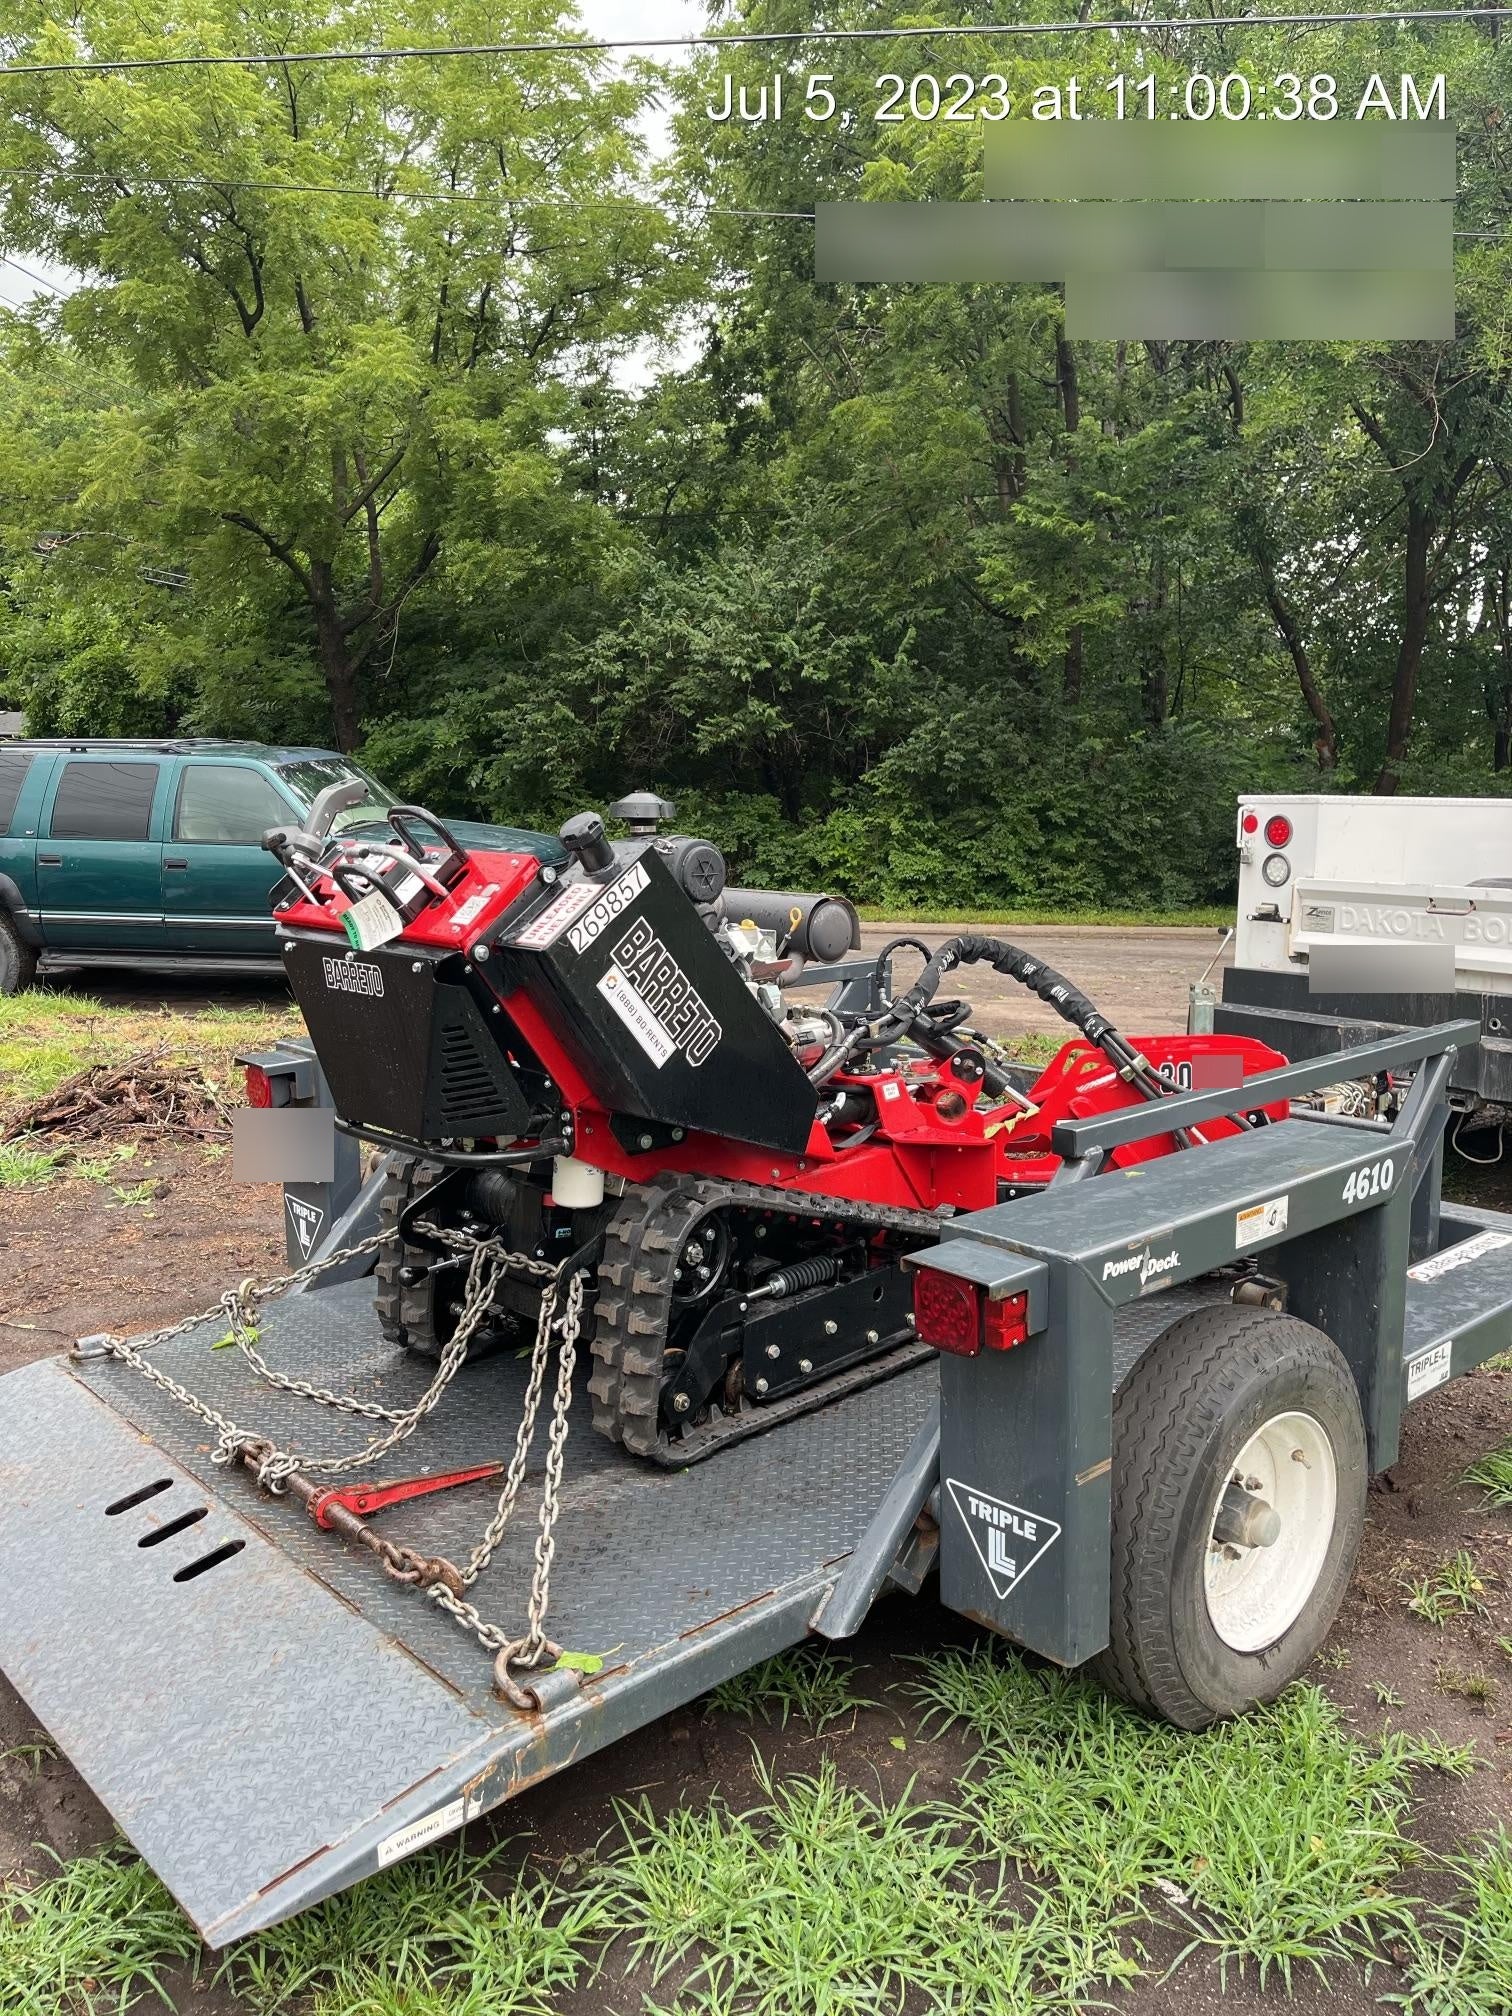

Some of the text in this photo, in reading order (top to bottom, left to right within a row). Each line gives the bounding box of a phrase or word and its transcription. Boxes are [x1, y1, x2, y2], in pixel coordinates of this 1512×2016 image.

[525, 887, 582, 940] UNLEADED
[538, 887, 594, 941] FUEL ONLY
[570, 866, 643, 951] 269857
[1341, 906, 1444, 938] DAKOTA
[323, 957, 385, 997] BARRETO
[610, 916, 723, 1067] BARRETO
[616, 990, 637, 1017] (888)
[1342, 1159, 1394, 1204] 4610
[292, 1202, 317, 1223] TRIPLE
[1102, 1254, 1144, 1281] Power
[968, 1495, 1037, 1542] TRIPLE
[396, 1821, 440, 1849] WARNING
